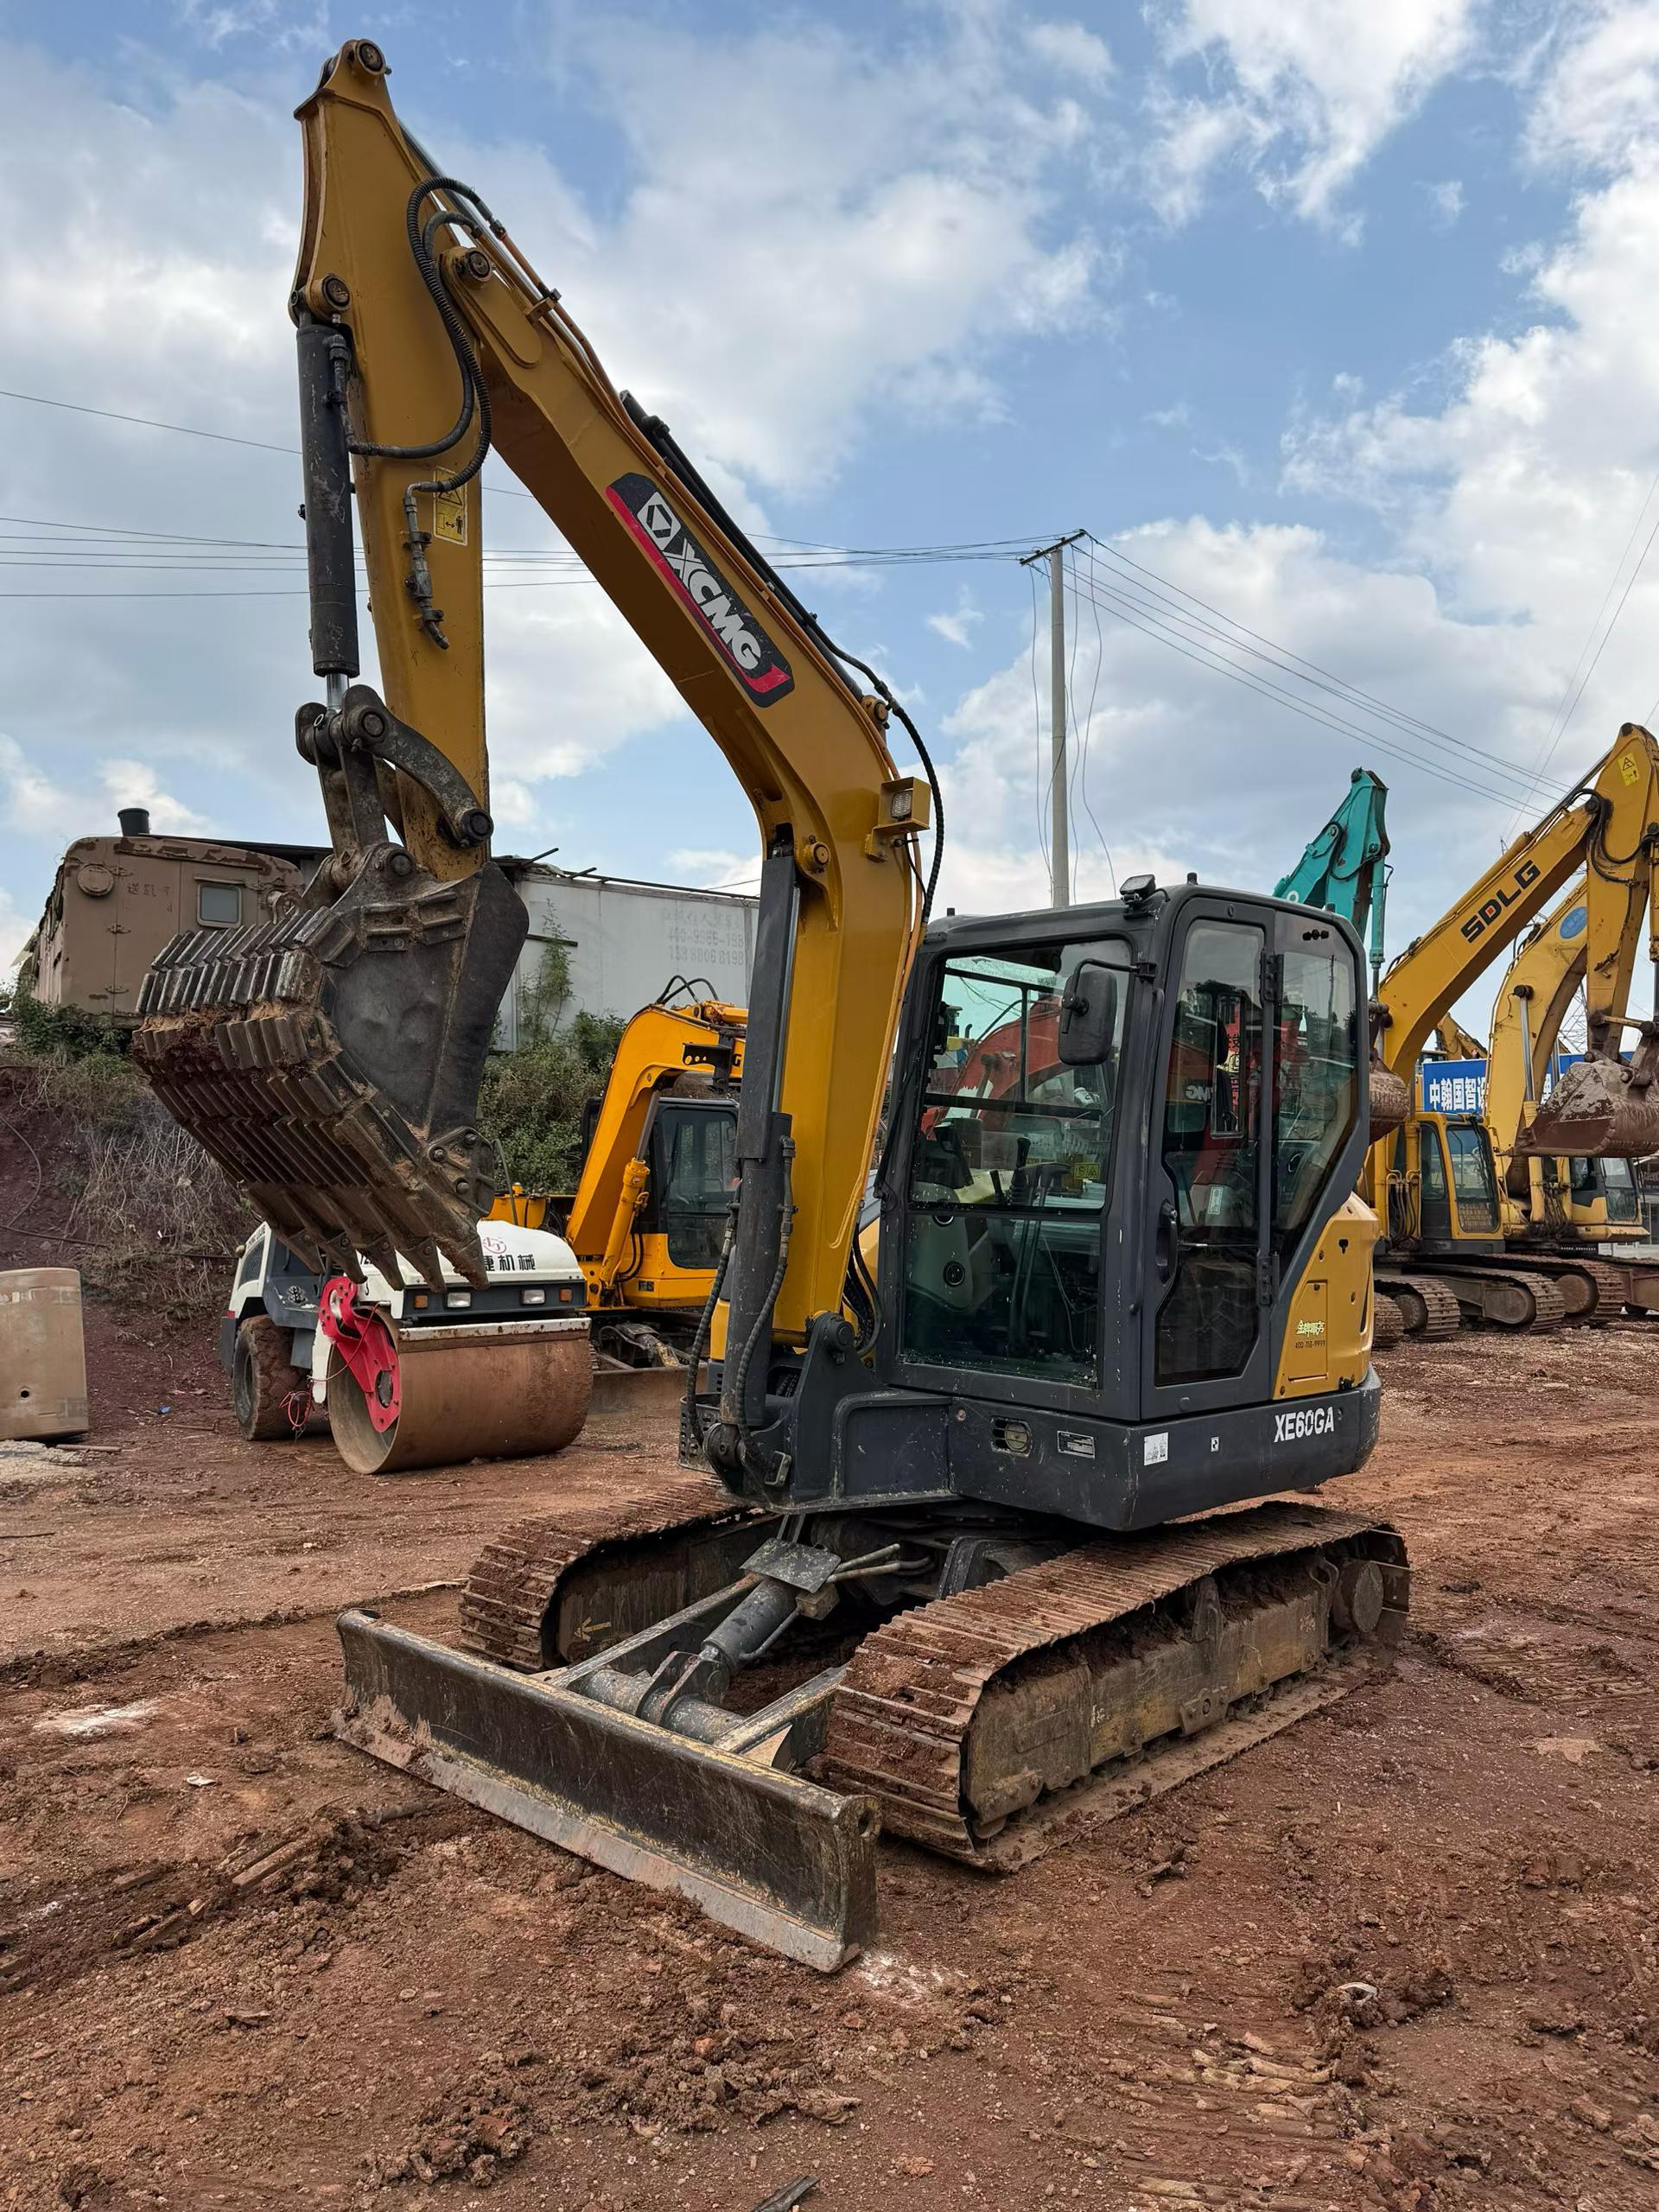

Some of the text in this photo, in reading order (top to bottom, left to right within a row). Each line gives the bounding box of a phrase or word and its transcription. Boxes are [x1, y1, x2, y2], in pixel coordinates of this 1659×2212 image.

[663, 537, 761, 670] XCMG
[1460, 860, 1541, 944] SDLG
[1274, 1406, 1335, 1443] XE60GA
